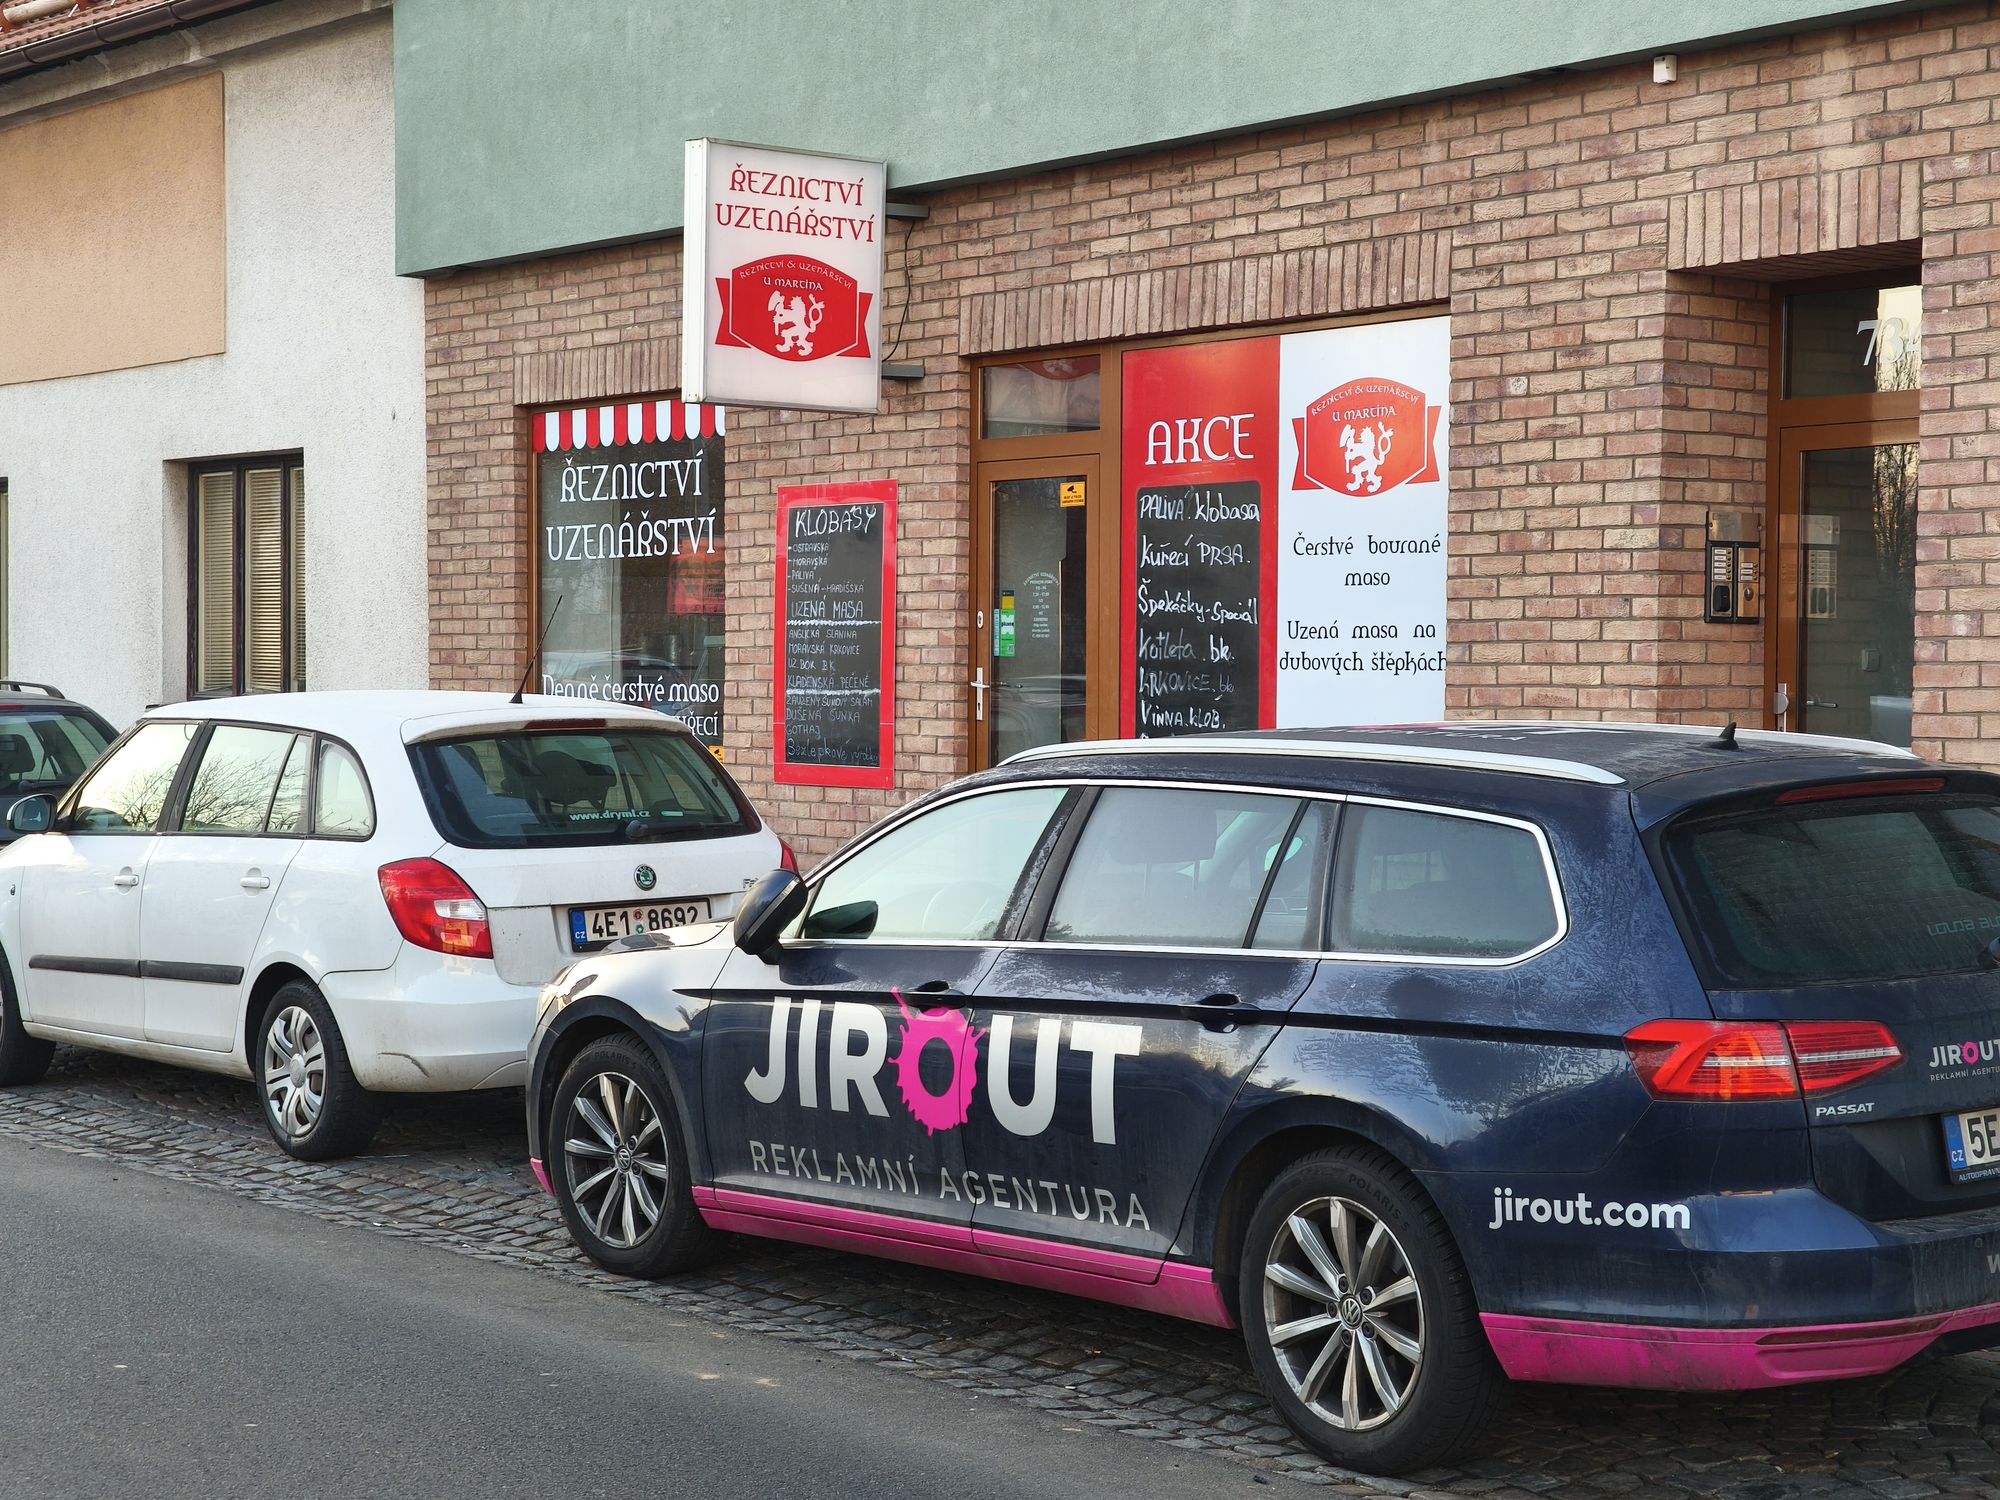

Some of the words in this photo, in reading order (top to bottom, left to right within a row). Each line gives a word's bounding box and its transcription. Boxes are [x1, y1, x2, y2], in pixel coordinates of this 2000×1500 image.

[729, 163, 864, 206] ŘEZNICTVÍ
[715, 203, 875, 243] UZENÁŘSTVÍ
[764, 277, 771, 286] U
[775, 276, 823, 291] MARTINA
[1332, 411, 1340, 421] U
[1344, 403, 1396, 420] MARTINA
[1145, 413, 1255, 465] AKCE
[560, 449, 703, 502] ŘEZNICTVÍ
[546, 507, 716, 561] UZENÁŘSTVÍ
[1293, 531, 1354, 556] Čerstvé
[1368, 533, 1441, 554] bourané
[1344, 570, 1391, 586] maso
[833, 601, 864, 619] MASA
[826, 630, 857, 640] SLANINA
[1287, 620, 1339, 640] Uzená
[1352, 624, 1398, 639] masa
[1413, 624, 1435, 638] na
[800, 660, 816, 670] BOK
[1279, 651, 1364, 676] dubových
[603, 675, 664, 702] čerstvé
[668, 683, 719, 702] maso
[569, 810, 651, 822] www.dryml.cz
[575, 931, 586, 939] CZ
[592, 910, 630, 938] 4E1
[744, 988, 1143, 1145] JIROUT
[1816, 1102, 1875, 1117] PASSAT
[1951, 1150, 1964, 1162] CZ
[749, 1140, 920, 1195] REKLAMNÍ
[940, 1167, 1150, 1231] AGENTURA
[1489, 1187, 1690, 1230] jirout.com
